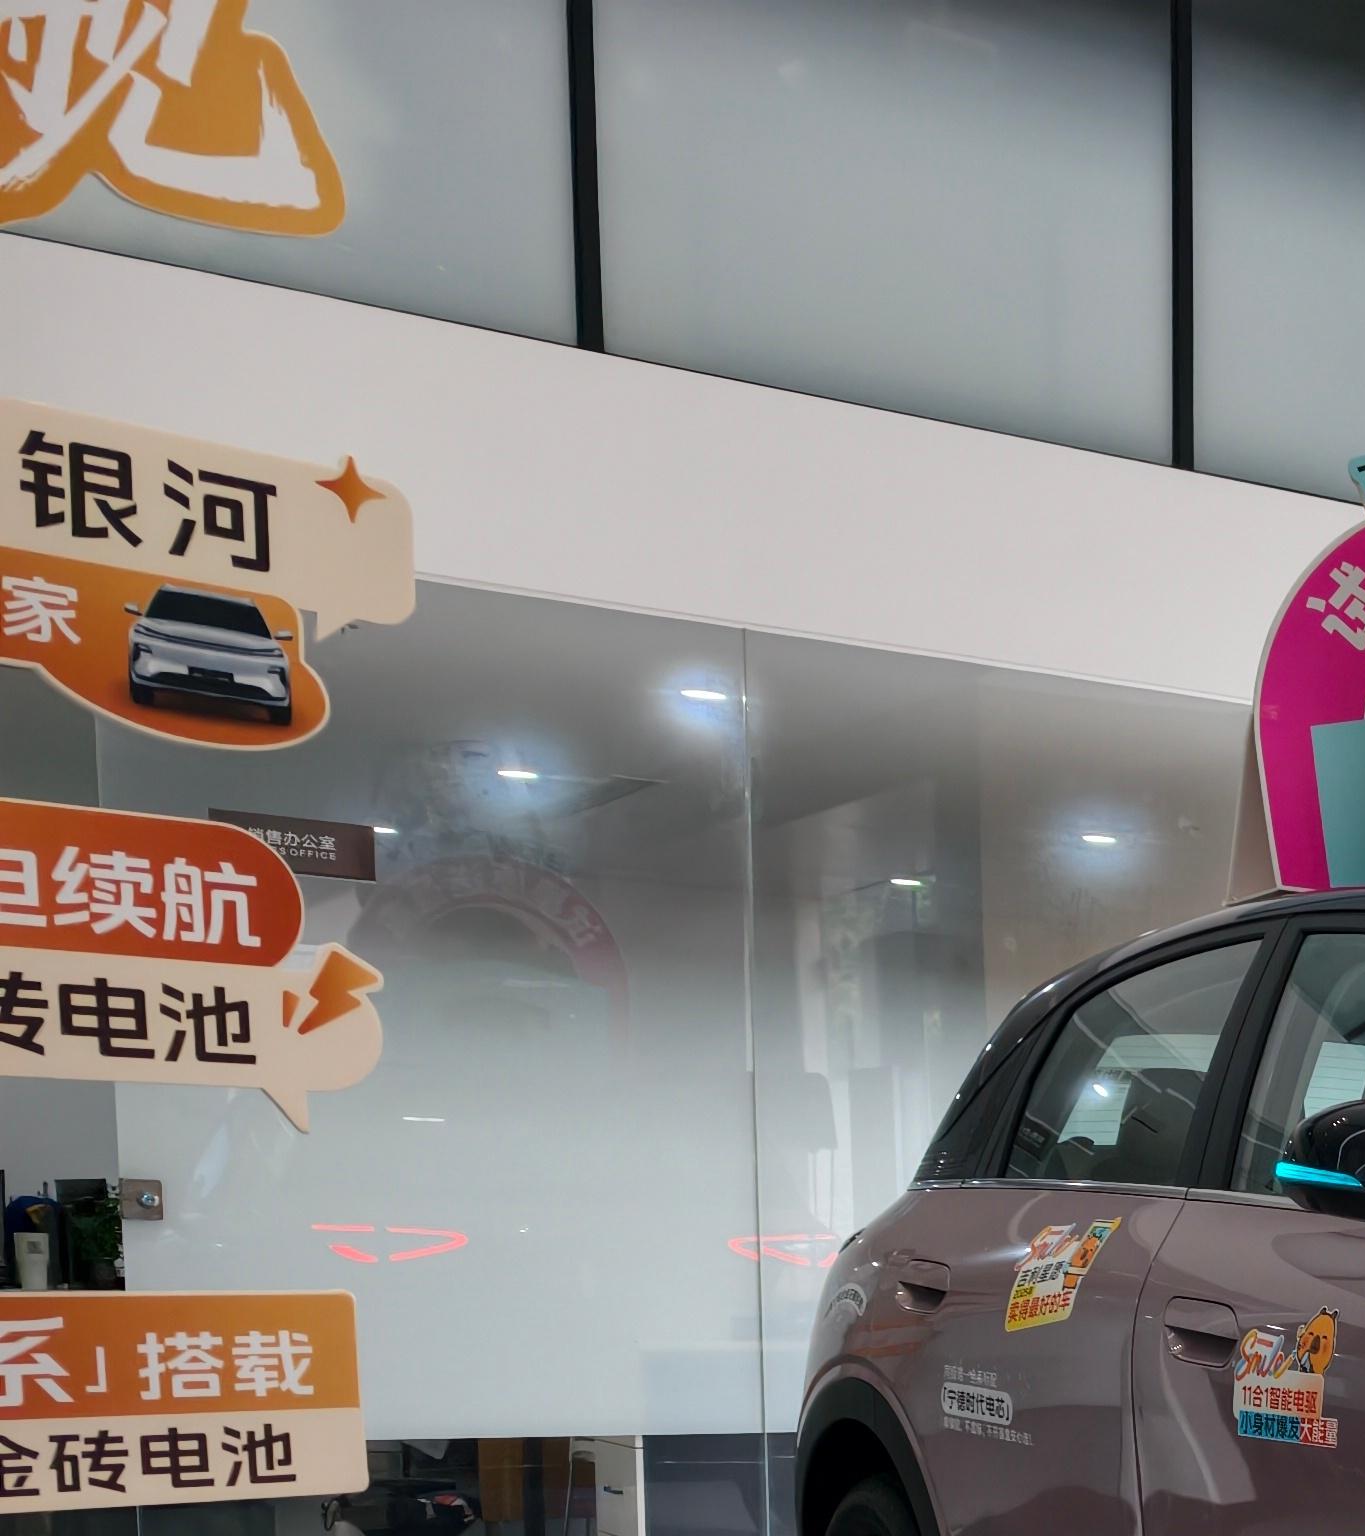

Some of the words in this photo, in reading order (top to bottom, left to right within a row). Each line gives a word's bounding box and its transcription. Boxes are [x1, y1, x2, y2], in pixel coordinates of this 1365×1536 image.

[18, 430, 277, 572] 银河
[2, 576, 81, 645] 家
[1008, 1291, 1073, 1323] 卖得最好的车
[1242, 1385, 1318, 1414] 11合1智能电驱
[1240, 1410, 1338, 1447] 小身材爆发大能量
